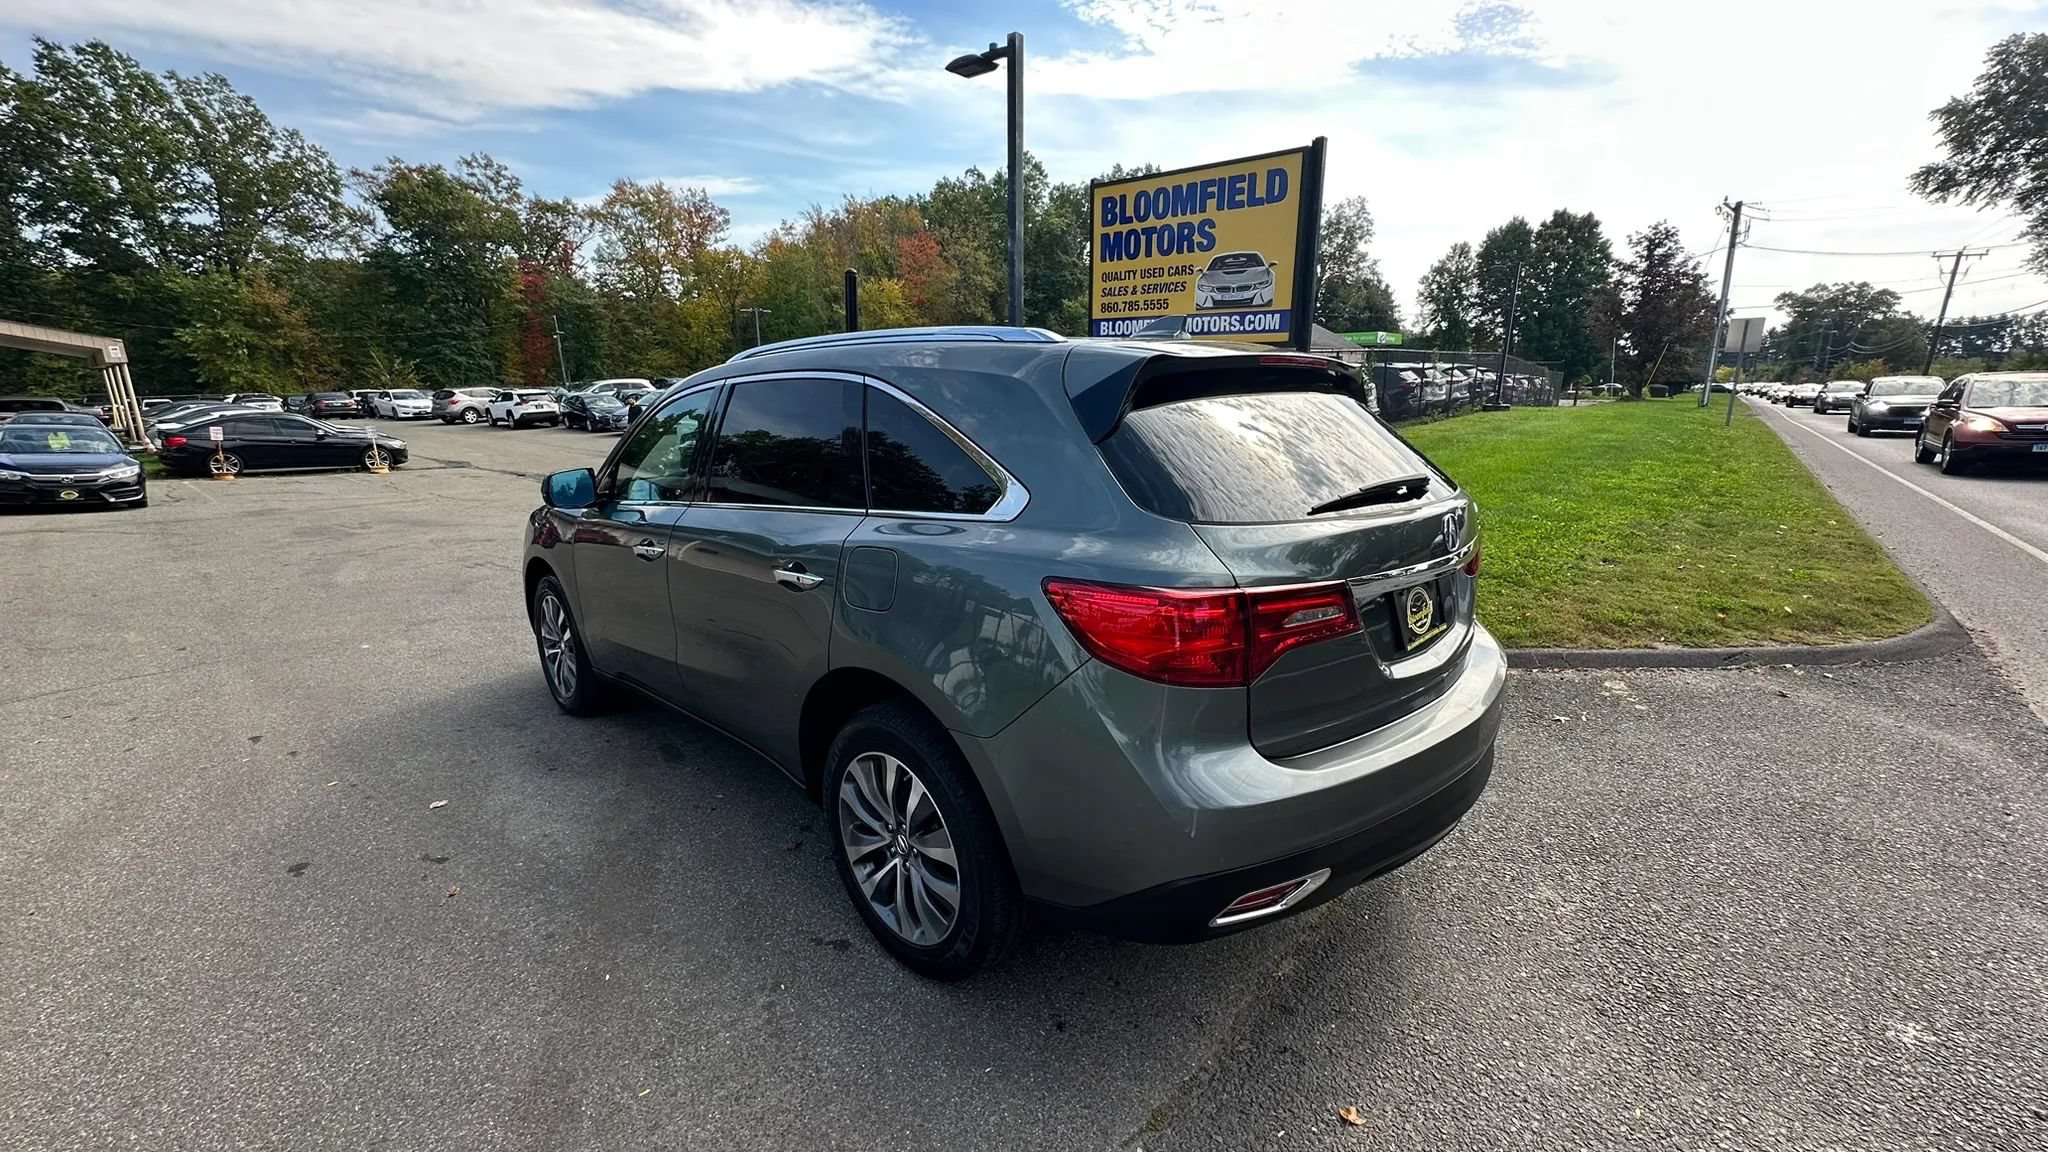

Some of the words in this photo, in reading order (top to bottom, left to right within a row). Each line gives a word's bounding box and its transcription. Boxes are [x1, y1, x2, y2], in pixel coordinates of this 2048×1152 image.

[1101, 168, 1288, 228] BLOOMFIELD
[1100, 218, 1217, 263] MOTORS
[1101, 269, 1138, 283] QUALITY
[1140, 267, 1165, 280] USED
[1167, 264, 1195, 277] CARS
[1101, 285, 1129, 298] SALES
[1130, 285, 1138, 296] &
[1140, 281, 1187, 295] SERVICES
[1100, 299, 1169, 313] 860.785.5555
